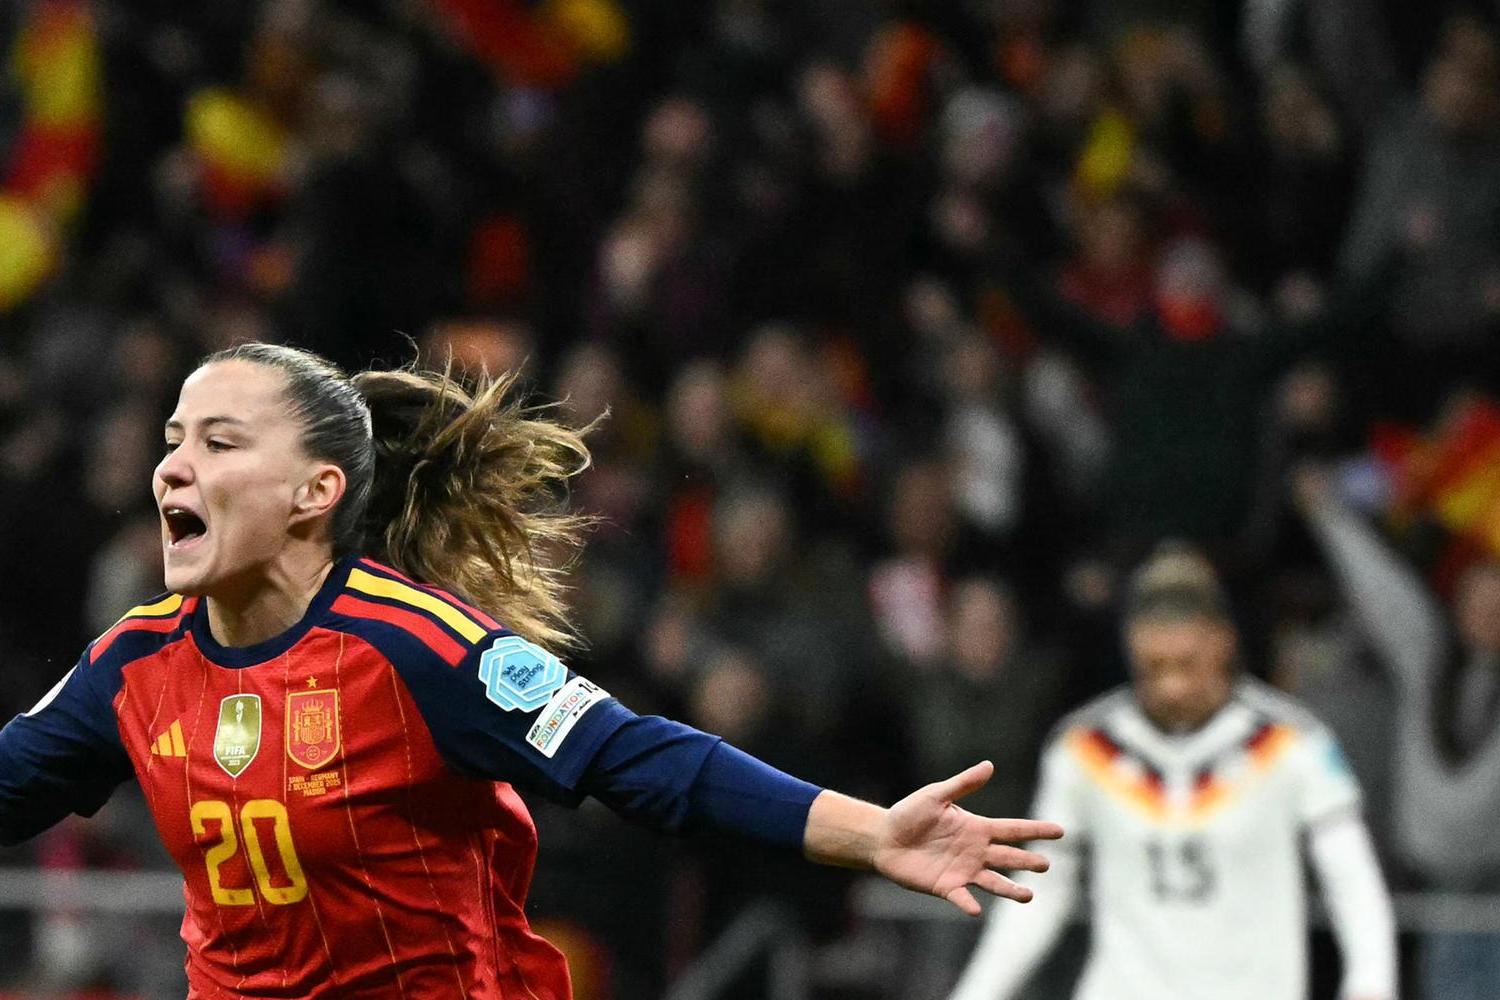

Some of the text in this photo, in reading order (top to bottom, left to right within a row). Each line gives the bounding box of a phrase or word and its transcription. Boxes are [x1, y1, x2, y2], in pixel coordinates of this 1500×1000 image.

[536, 690, 584, 749] FOUNDATION
[225, 744, 246, 756] FIFA
[190, 799, 308, 905] 20
